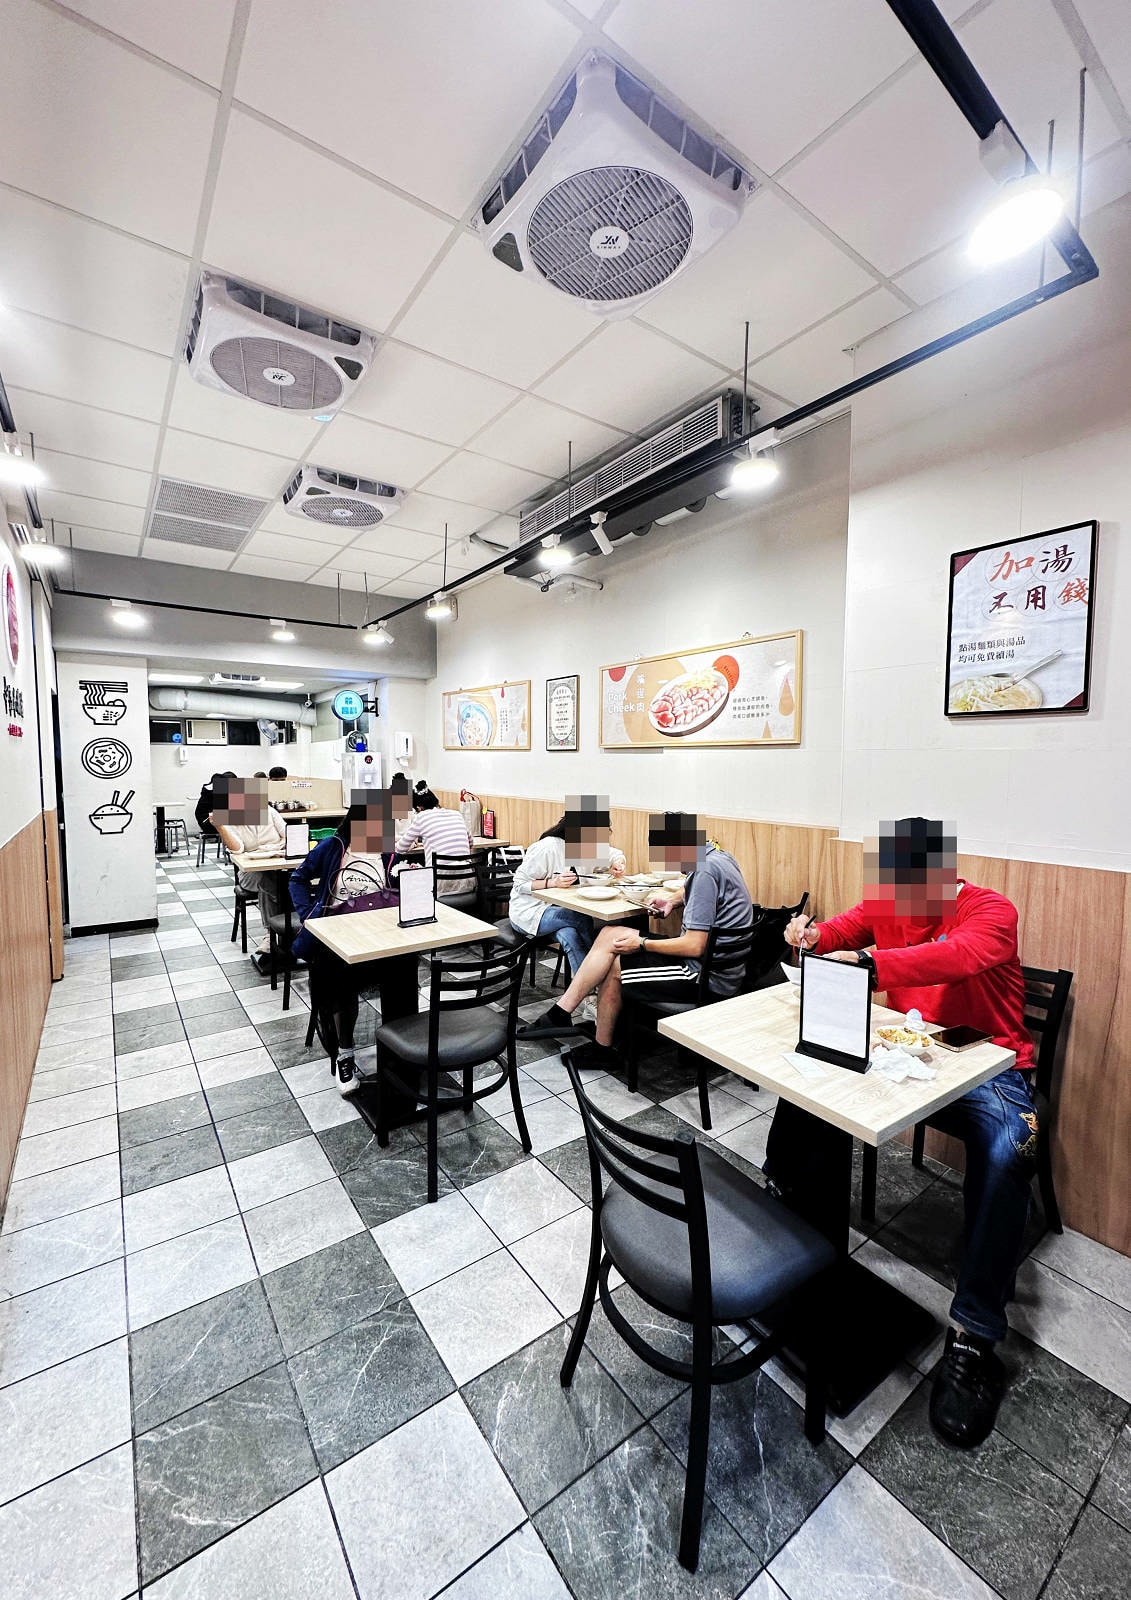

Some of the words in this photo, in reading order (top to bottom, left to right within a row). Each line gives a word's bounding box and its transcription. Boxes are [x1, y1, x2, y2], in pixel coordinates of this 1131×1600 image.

[990, 544, 1075, 582] 加湯
[988, 577, 1089, 614] 不用錢
[608, 692, 627, 702] Pork
[608, 701, 635, 714] Cheek
